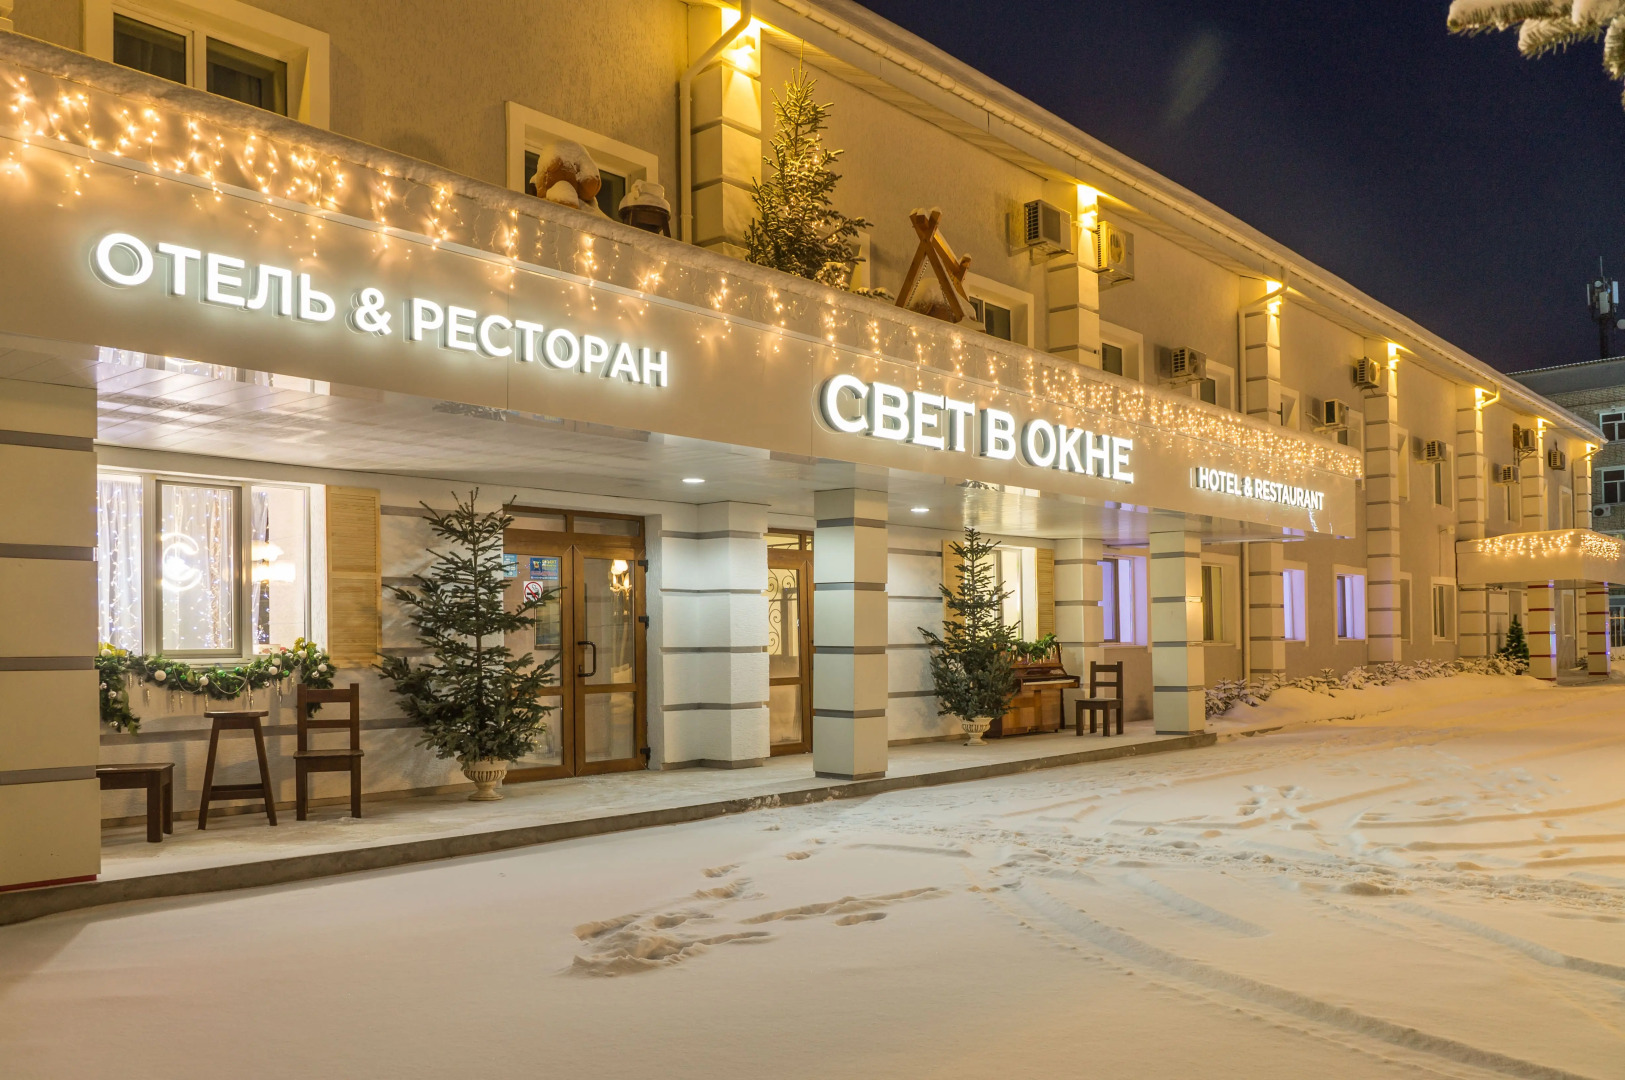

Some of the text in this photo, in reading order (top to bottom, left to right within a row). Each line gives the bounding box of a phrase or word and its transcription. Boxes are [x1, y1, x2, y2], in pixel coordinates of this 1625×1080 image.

[95, 232, 669, 388] ОТЕЛЬ & РЕСТОРАН
[825, 374, 1135, 485] СВЕТ В ОКНЕ
[1198, 466, 1325, 511] HOTEL & RESTAURANT
